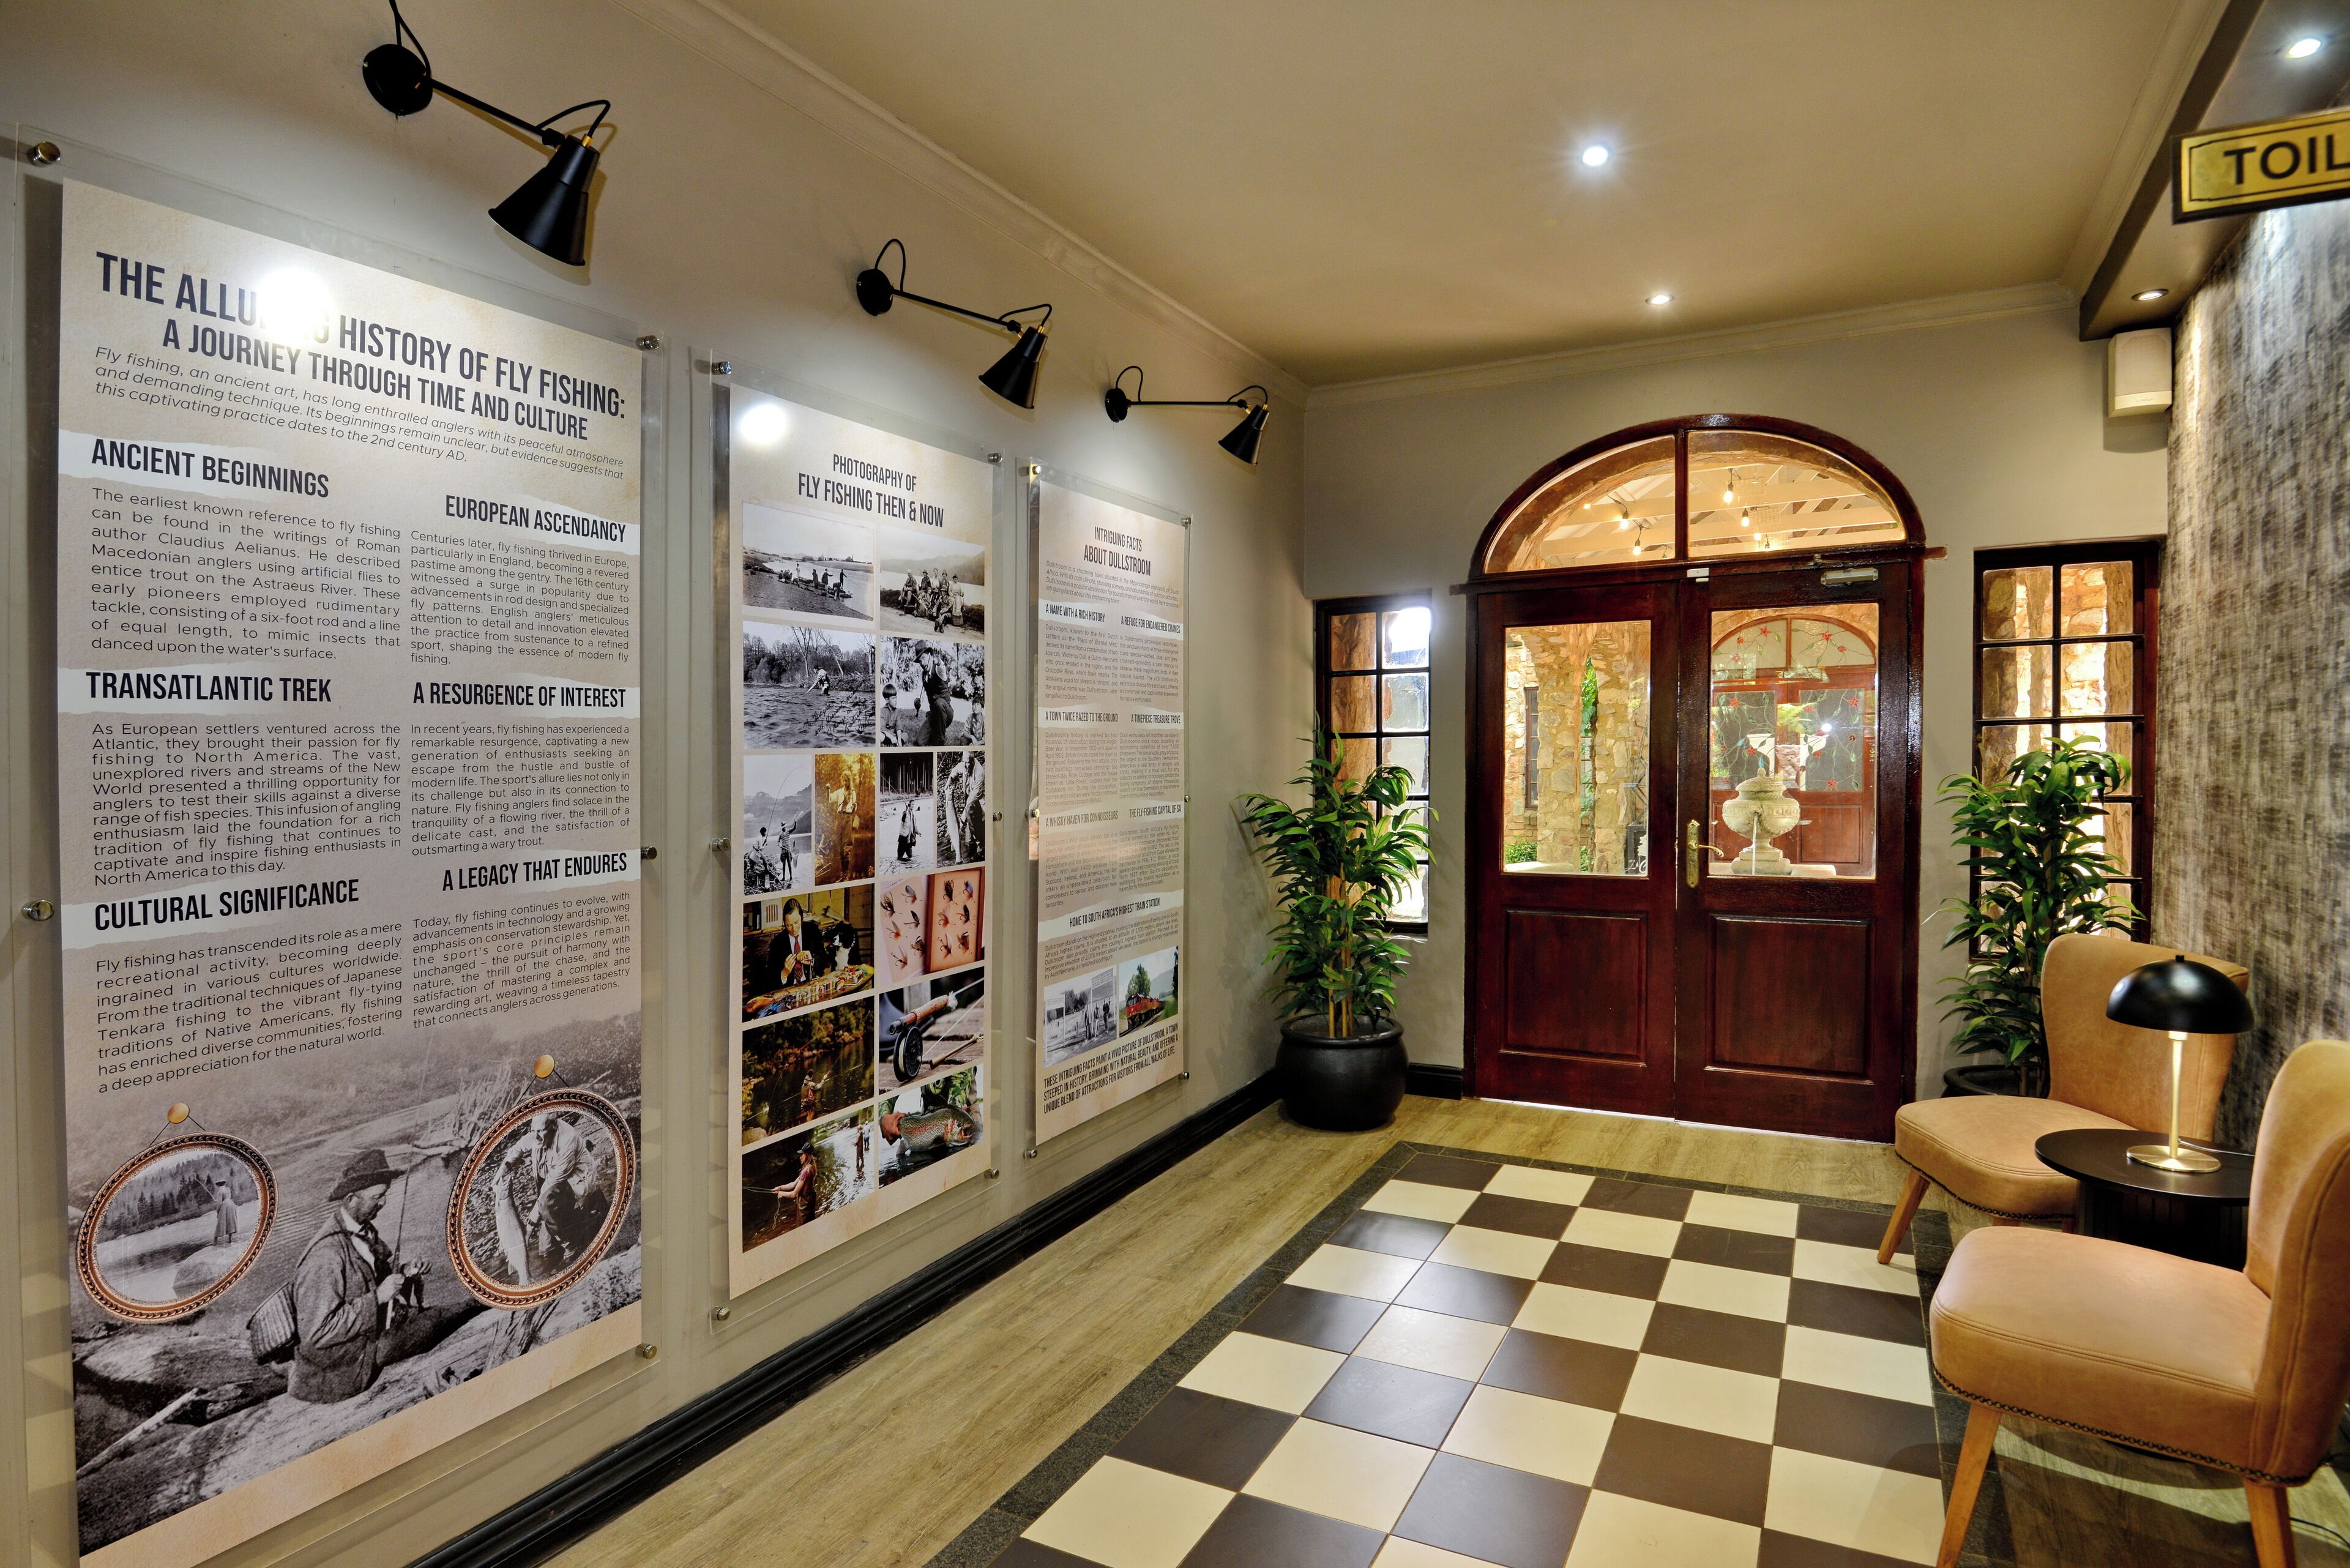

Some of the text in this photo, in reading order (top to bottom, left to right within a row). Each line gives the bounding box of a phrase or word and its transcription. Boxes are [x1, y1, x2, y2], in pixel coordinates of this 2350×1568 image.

[97, 252, 624, 419] THE ALLUG HISTORY OF FLY FISHING:
[163, 319, 588, 440] A JOURNEY THROUGH TIME AND CULTURE
[96, 347, 623, 466] Fly fishing, an ancient art, has long enthralled anglers with its peaceful atmosphere
[92, 439, 328, 498] ANCIENT BEGINNINGS
[834, 454, 916, 491] PHOTOGRAPHY OF
[92, 488, 400, 539] The earliest known reference to fly fishing
[799, 473, 943, 527] FLY FISHING THEN & NOW
[446, 495, 625, 542] EUROPEAN ASCENDANCY
[1095, 526, 1142, 551] INTRIGUING FACTS
[1084, 545, 1151, 576] ABOUT DULLSTROOM
[1046, 604, 1105, 622] A NAME WITH A RICH HISTORY
[1121, 616, 1124, 624] A
[1125, 616, 1138, 627] REFUGE
[1146, 620, 1167, 631] ENDANGERED
[1168, 624, 1180, 633] CRANES
[411, 652, 450, 665] fishing.
[86, 672, 331, 701] TRANSATLANTIC TREK
[414, 682, 625, 707] A RESURGENCE OF INTEREST
[92, 724, 113, 734] As
[122, 724, 197, 736] European
[206, 724, 259, 734] settlers
[267, 724, 326, 734] ventured
[381, 725, 400, 733] the
[1046, 711, 1048, 720] A
[1050, 711, 1061, 720] TOWN
[1062, 712, 1075, 721] TWICE
[1076, 712, 1088, 721] RAZED
[1089, 712, 1094, 722] TO
[1103, 713, 1117, 722] GROUND
[1135, 714, 1154, 723] TIMEPIECE
[1153, 715, 1169, 723] TREASURE
[1046, 818, 1048, 827] A
[1050, 816, 1066, 827] WHISKY
[1067, 815, 1080, 824] HAVEN
[1090, 810, 1118, 822] CONNOISSEURS
[1137, 807, 1157, 816] FLY-FISHING
[1158, 805, 1171, 815] CAPITAL
[412, 843, 479, 856] outsmarting
[490, 841, 515, 849] wary
[518, 837, 543, 846] trout.
[443, 853, 627, 891] A LEGACY THAT ENDURES
[95, 879, 359, 930] CULTURAL SIGNIFICANCE
[1070, 898, 1160, 927] HOME TO SOUTH AFRICA'S HIGHEST TRAIN STATION
[1044, 1075, 1058, 1088] THESE
[1059, 1064, 1082, 1082] INTRIGUING
[1083, 1058, 1095, 1071] FACTS
[1096, 1053, 1107, 1066] PAINT
[1108, 1051, 1112, 1061] A
[1111, 1047, 1121, 1059] VIVID
[1122, 1041, 1136, 1055] PICTURE
[1138, 1039, 1143, 1047] OF
[1166, 1026, 1169, 1035] A
[1169, 1023, 1177, 1033] TOWN
[1044, 1086, 1062, 1101] STEEPED
[1064, 1083, 1069, 1092] IN
[1089, 1064, 1109, 1081] BRIMMING
[1110, 1059, 1119, 1071] WITH
[1121, 1053, 1136, 1066] NATURAL
[1160, 1036, 1175, 1048] OFFERING
[1044, 1098, 1060, 1114] UNIQUE
[1061, 1092, 1075, 1106] BLEND
[1076, 1089, 1081, 1099] OF
[1082, 1078, 1108, 1096] ATTRACTIONS
[1109, 1073, 1117, 1083] FOR
[1117, 1066, 1133, 1080] VISITORS
[1134, 1061, 1144, 1072] FROM
[1152, 1054, 1162, 1064] WALKS
